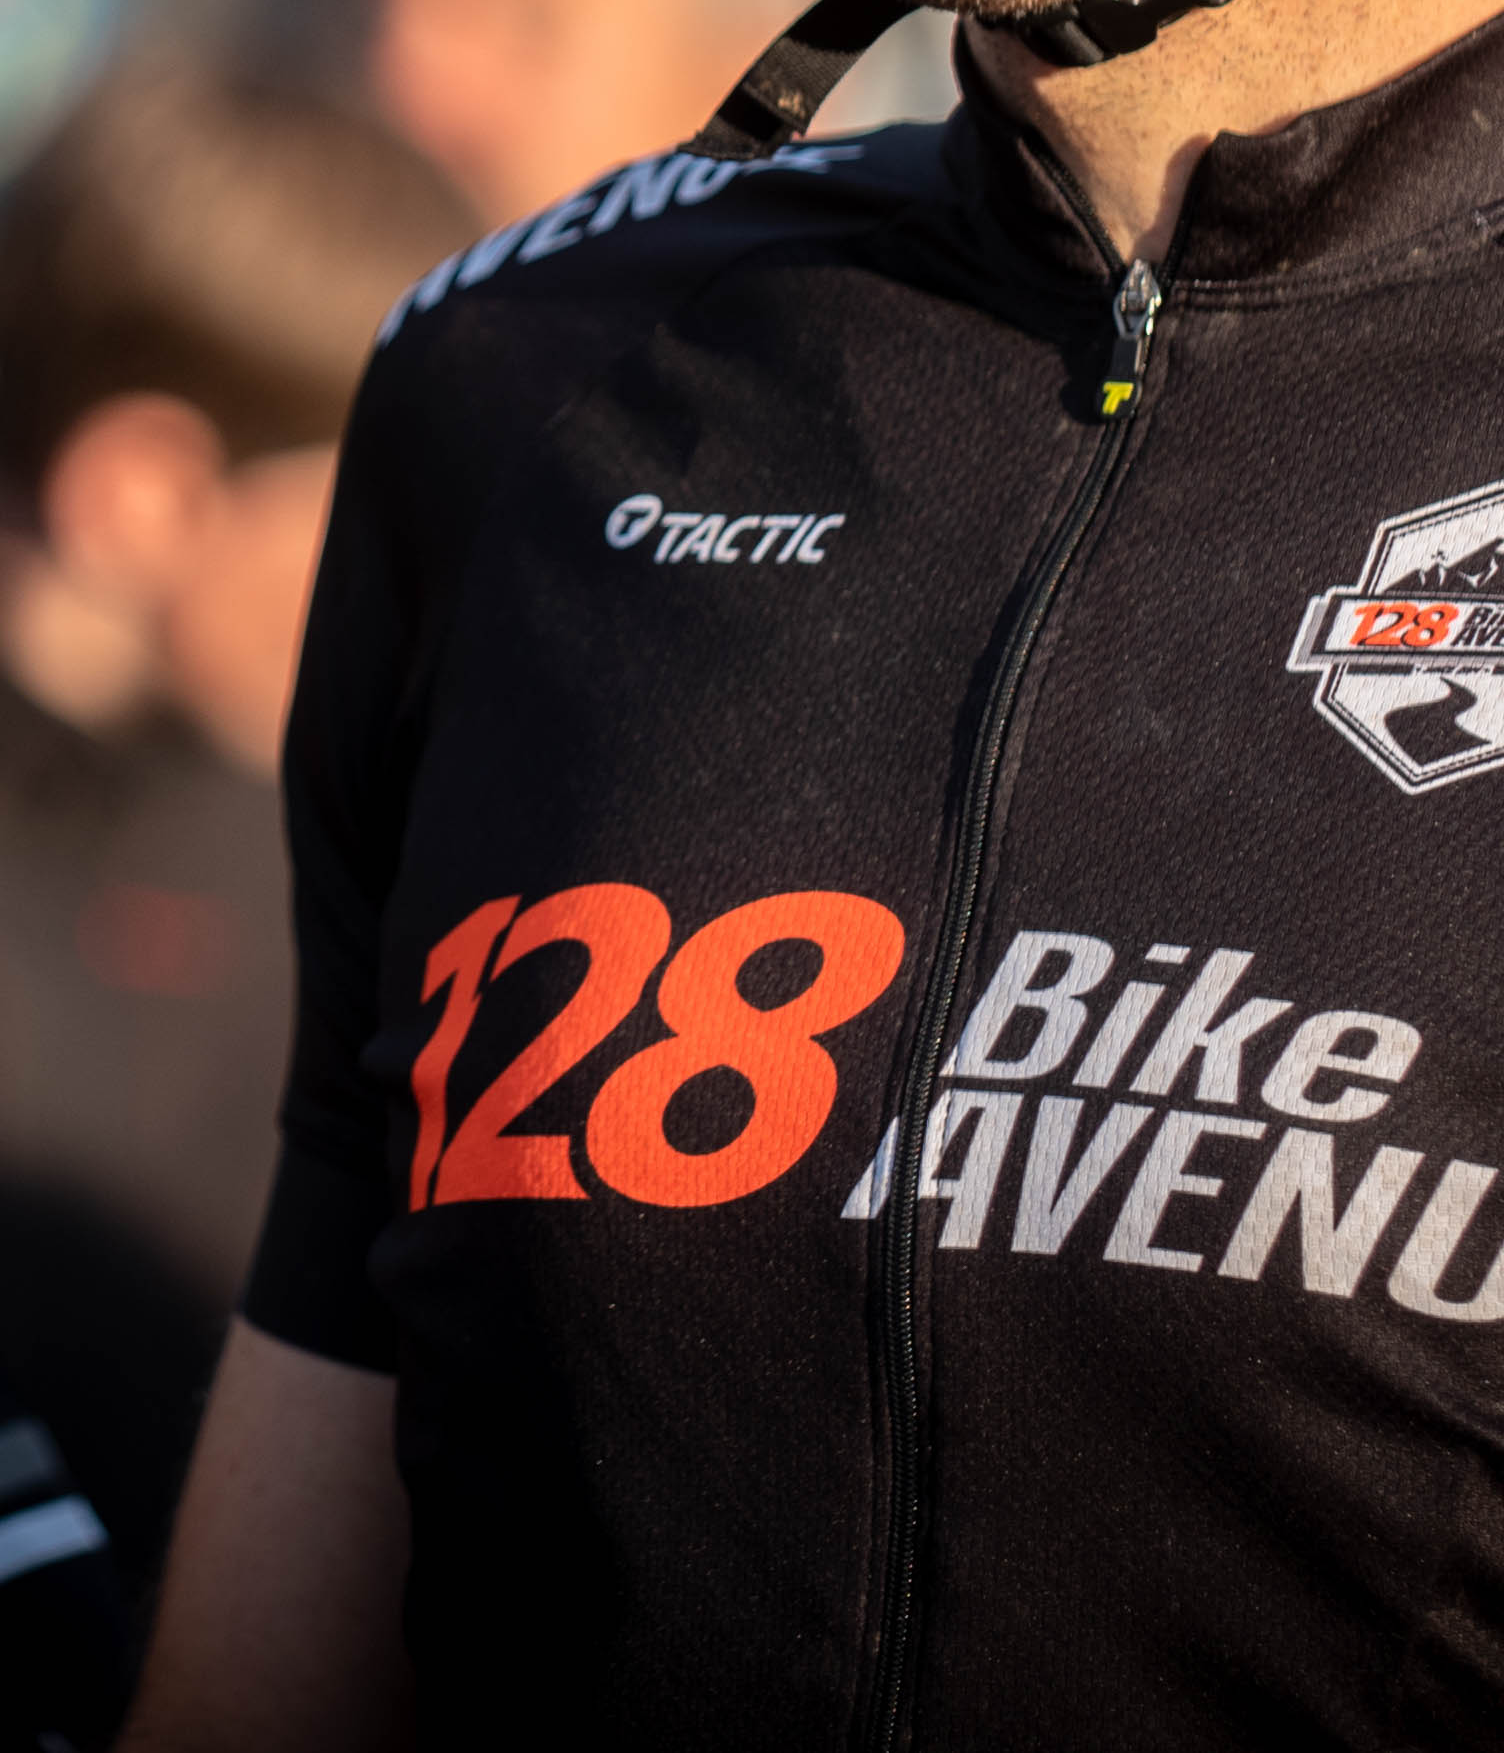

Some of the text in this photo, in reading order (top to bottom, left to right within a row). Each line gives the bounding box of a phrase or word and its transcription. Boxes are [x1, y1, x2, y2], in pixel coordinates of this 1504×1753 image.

[653, 512, 846, 564] TACTIC
[1348, 602, 1460, 648] 128
[408, 881, 1422, 1213] 128 Bike
